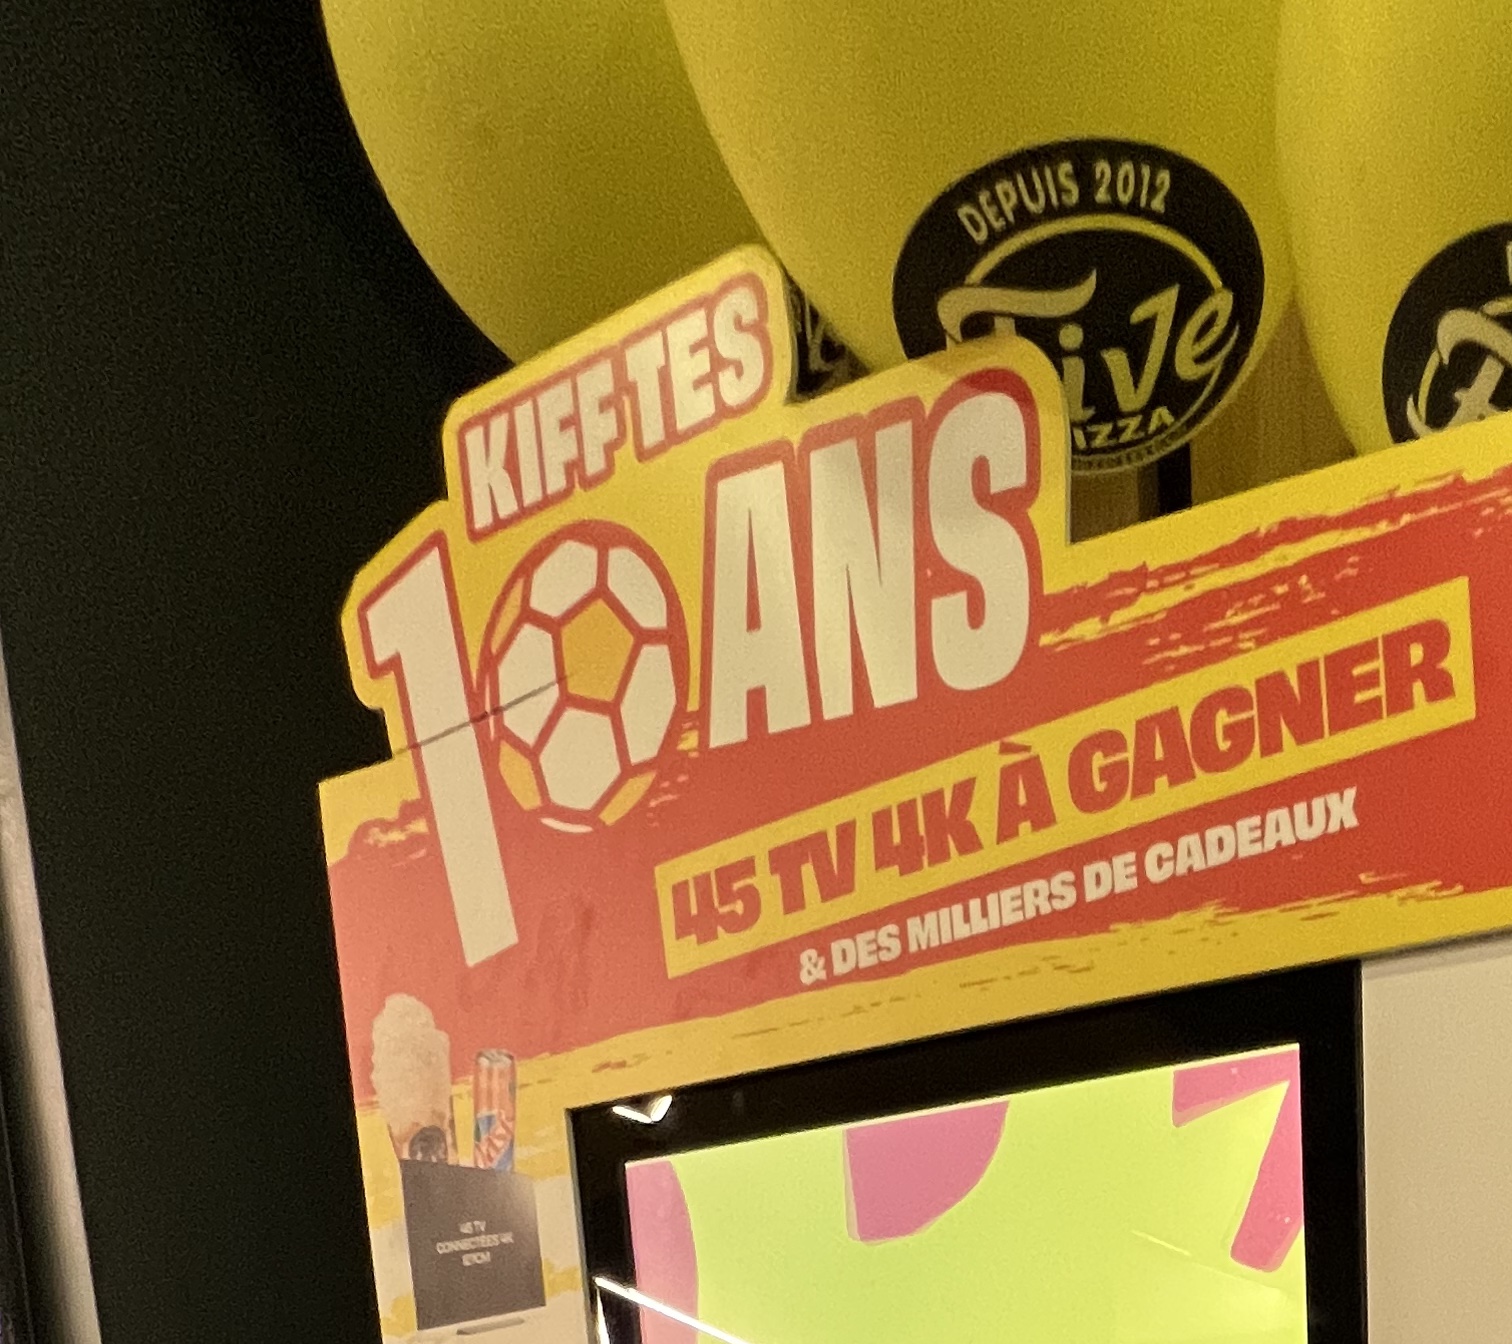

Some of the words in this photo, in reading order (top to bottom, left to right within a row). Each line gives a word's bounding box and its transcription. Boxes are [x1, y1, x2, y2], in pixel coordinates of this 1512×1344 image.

[956, 160, 1080, 246] DEPUIS
[1094, 158, 1172, 214] 2012
[463, 356, 625, 534] KIFF
[622, 285, 768, 452] TES
[1071, 405, 1175, 450] IZZA
[709, 390, 1031, 750] ANS
[671, 856, 762, 946] 45
[769, 815, 861, 915] TV
[873, 776, 985, 874] 4K
[994, 739, 1058, 845] À
[1067, 618, 1457, 819] GAGNER
[799, 946, 827, 986] &
[830, 925, 902, 982] DES
[908, 869, 1078, 955] MILLIERS
[1084, 851, 1138, 903] DE
[1144, 787, 1360, 885] CADEAUX
